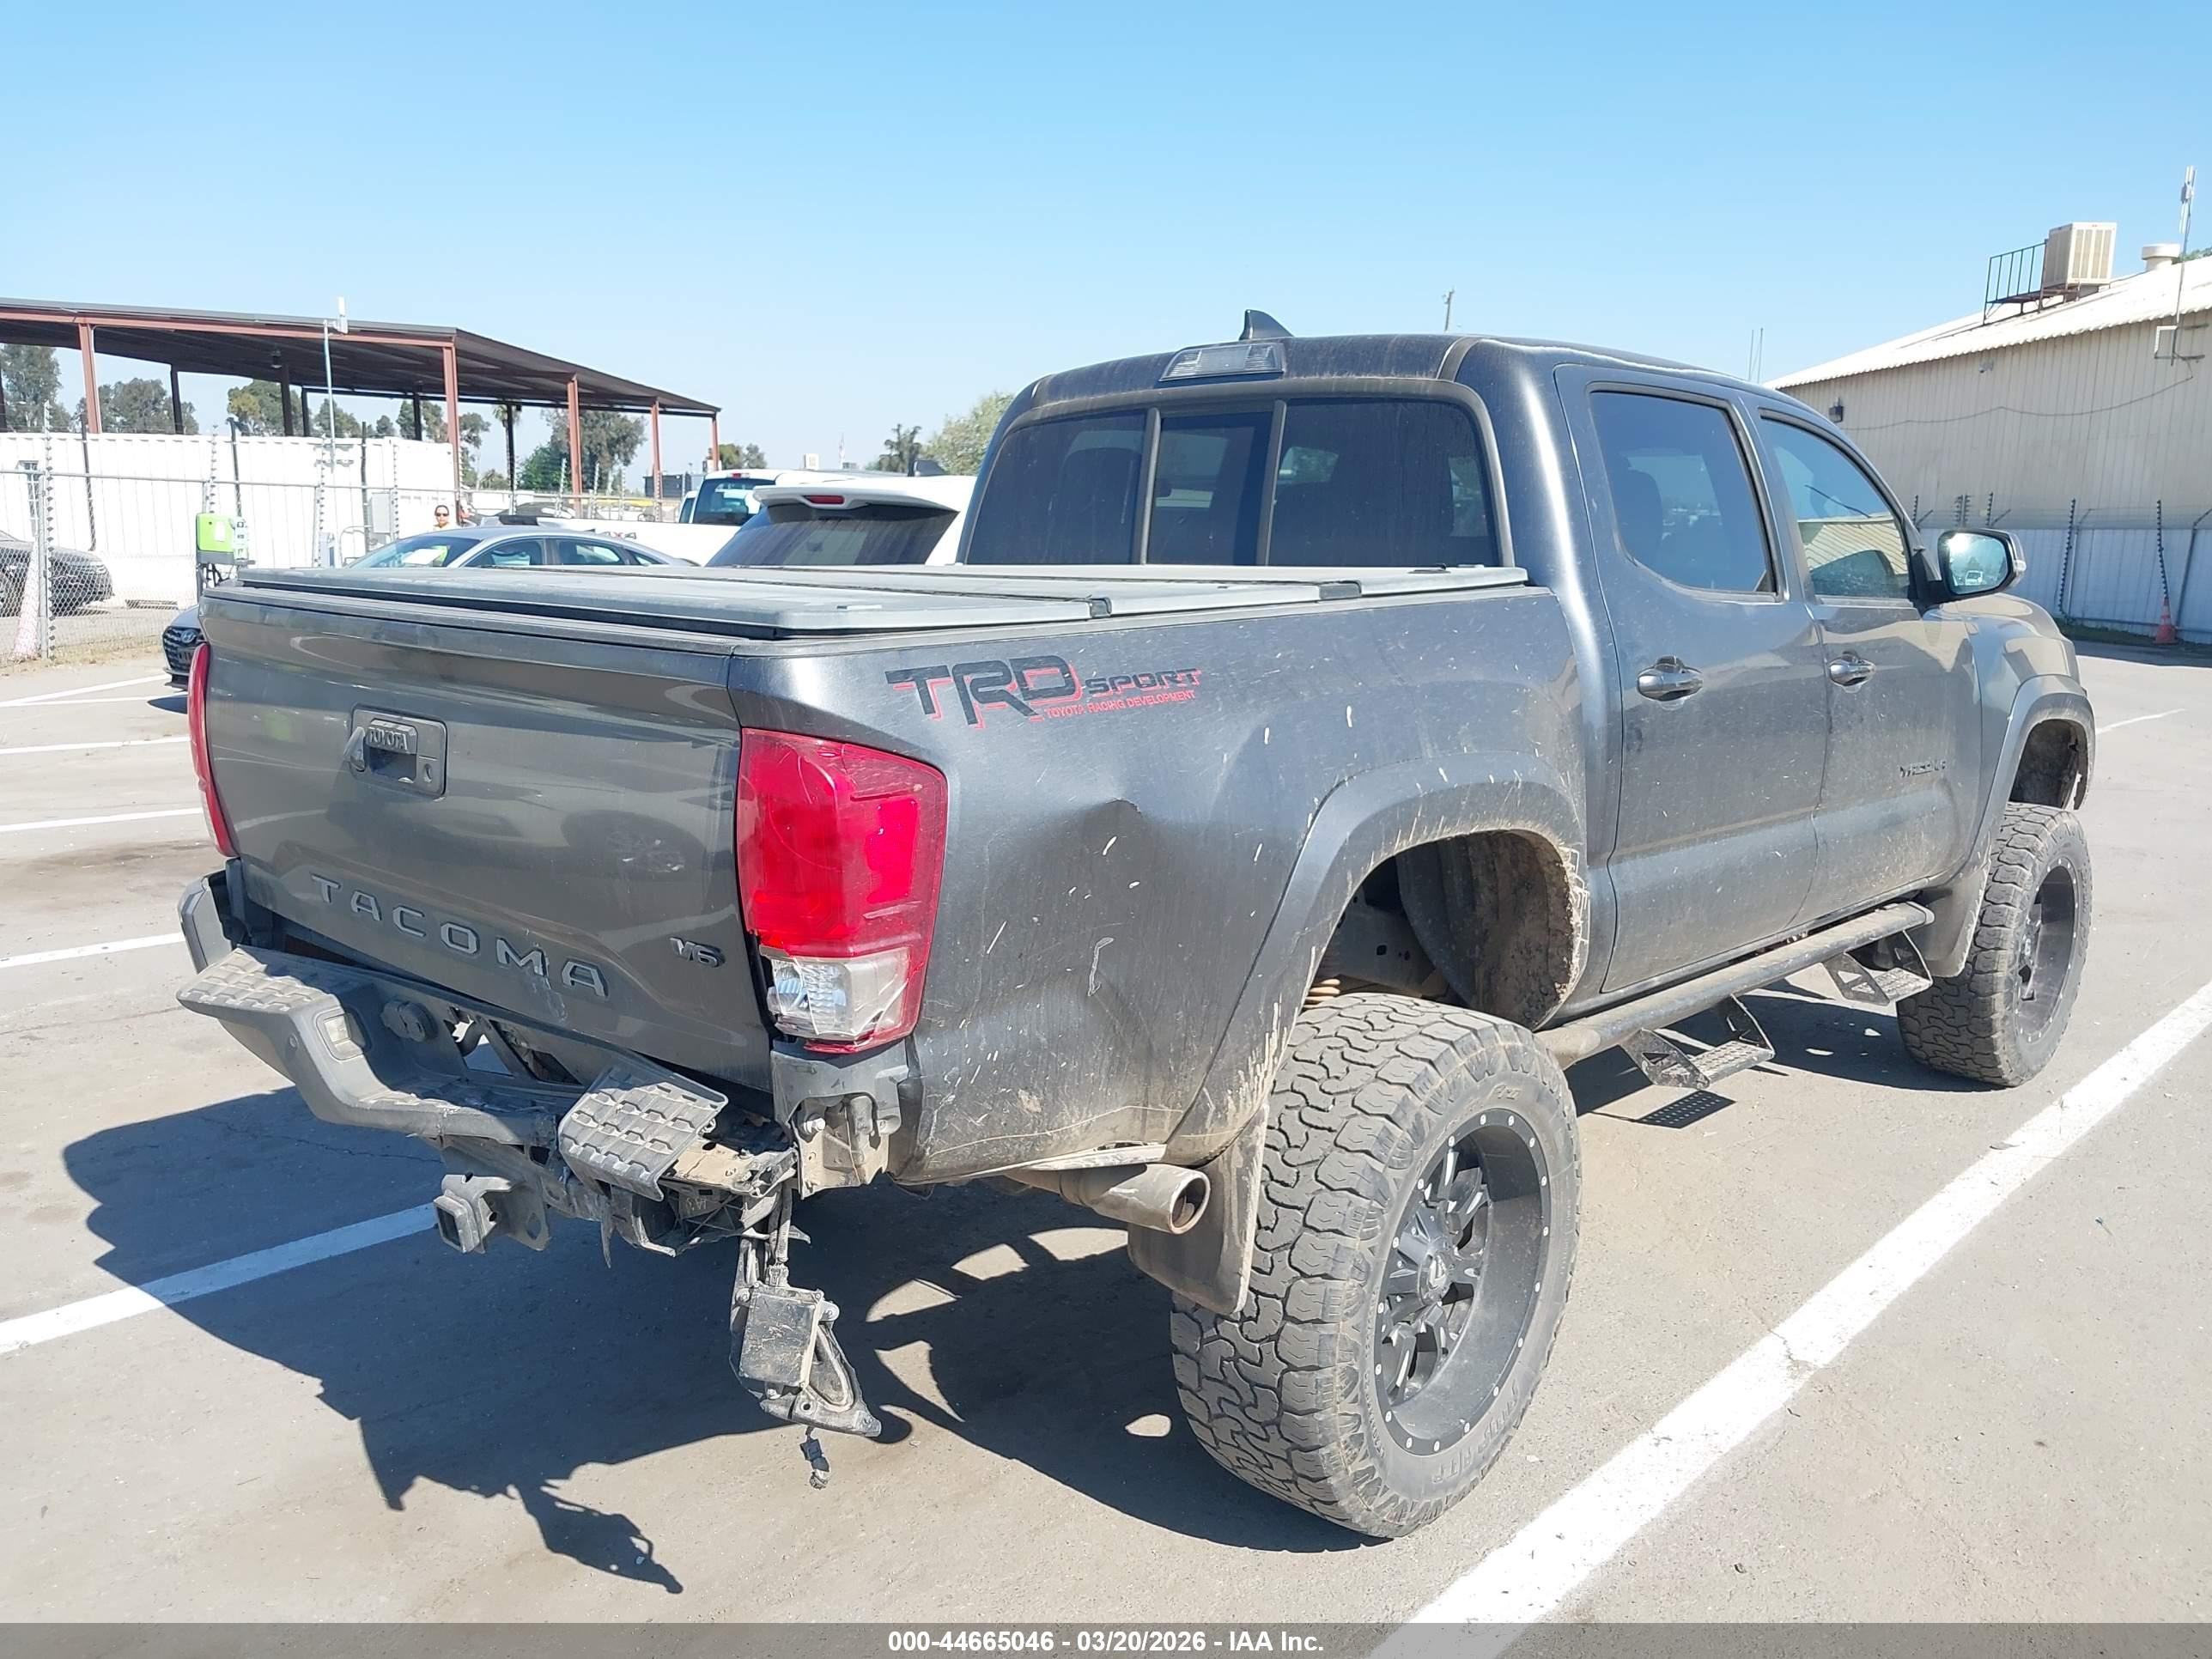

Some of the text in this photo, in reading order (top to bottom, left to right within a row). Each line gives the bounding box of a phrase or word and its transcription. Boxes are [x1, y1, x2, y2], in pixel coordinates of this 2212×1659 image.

[884, 655, 1202, 729] TRD SPORT
[1044, 690, 1196, 719] TOYOTA RACING DEVELOPMENT
[368, 726, 408, 750] TOYOTA
[310, 873, 609, 997] TACOMA
[670, 937, 725, 968] V6
